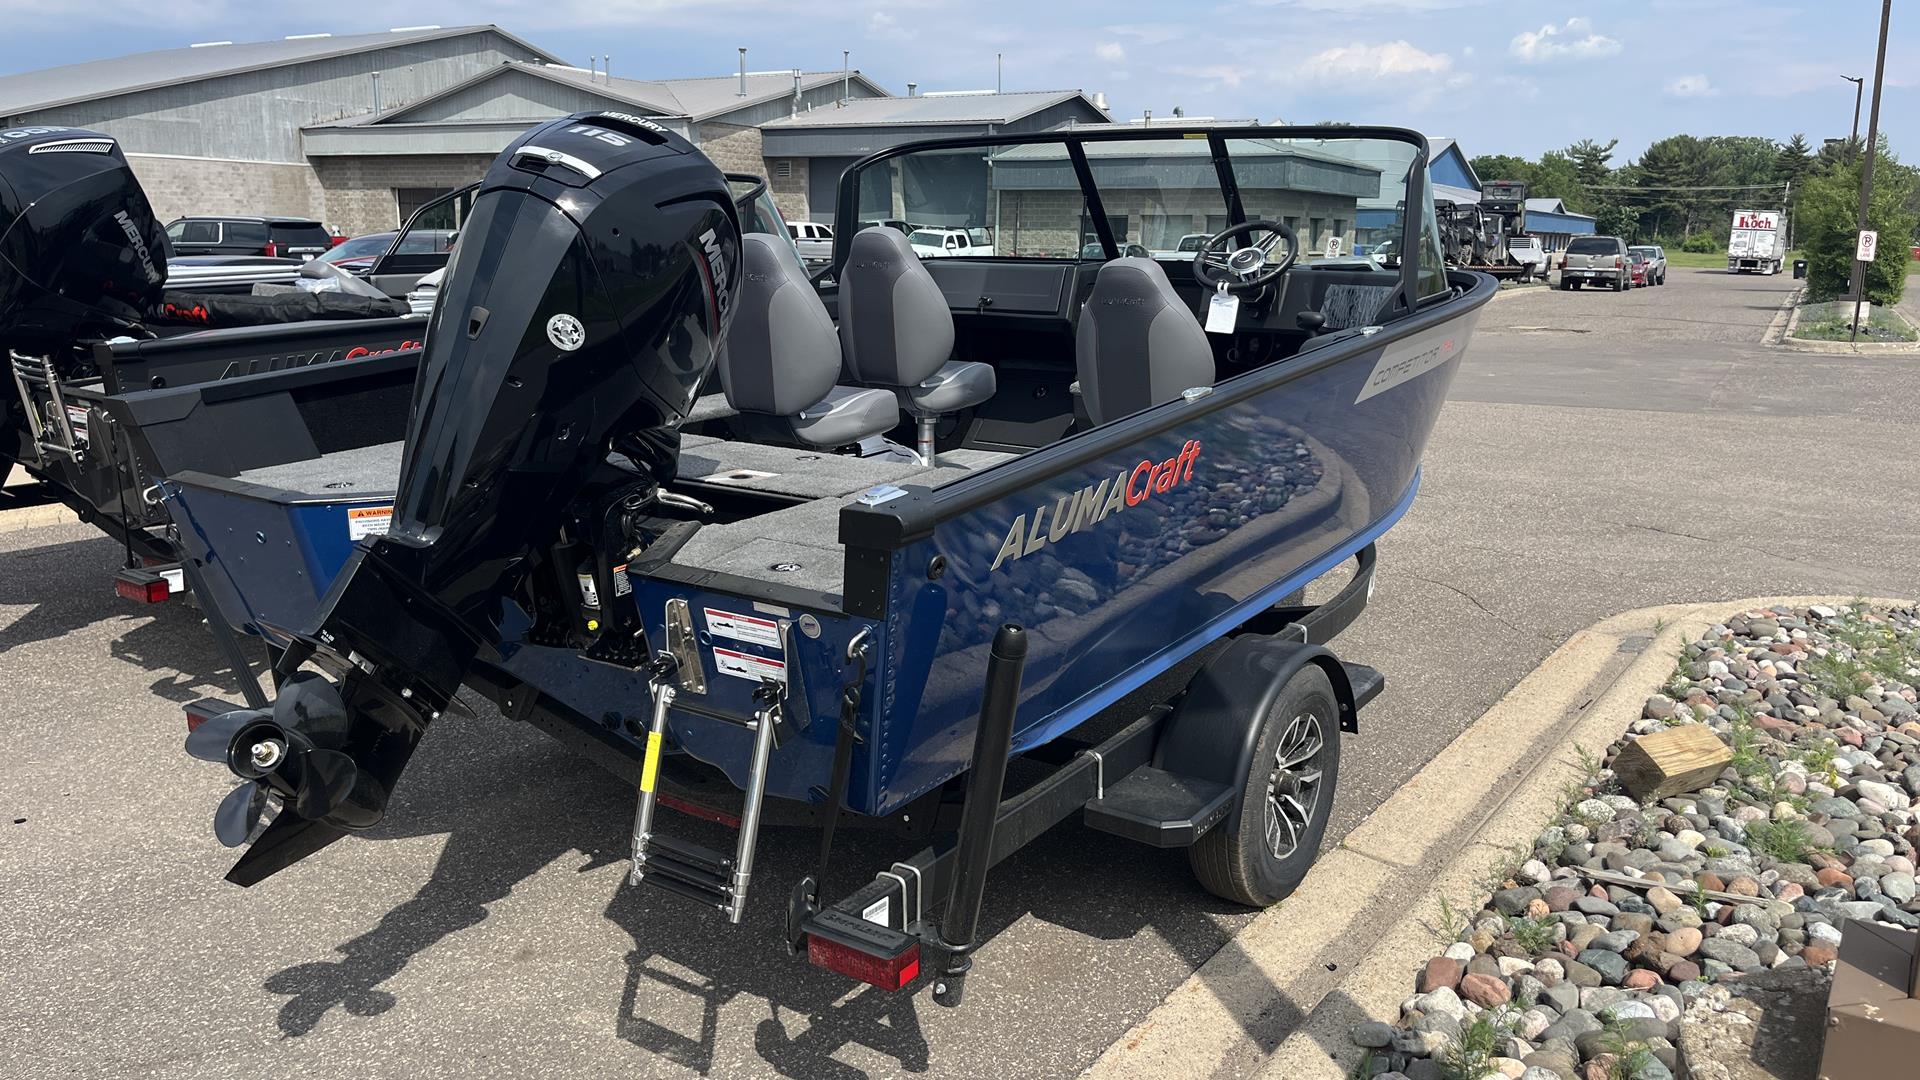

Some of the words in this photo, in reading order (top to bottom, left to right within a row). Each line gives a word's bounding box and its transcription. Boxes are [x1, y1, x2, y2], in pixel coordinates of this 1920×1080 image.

[600, 111, 669, 132] MERCURY
[568, 126, 632, 147] 115
[1738, 216, 1771, 229] Koch
[990, 439, 1201, 572] ALUMACraft
